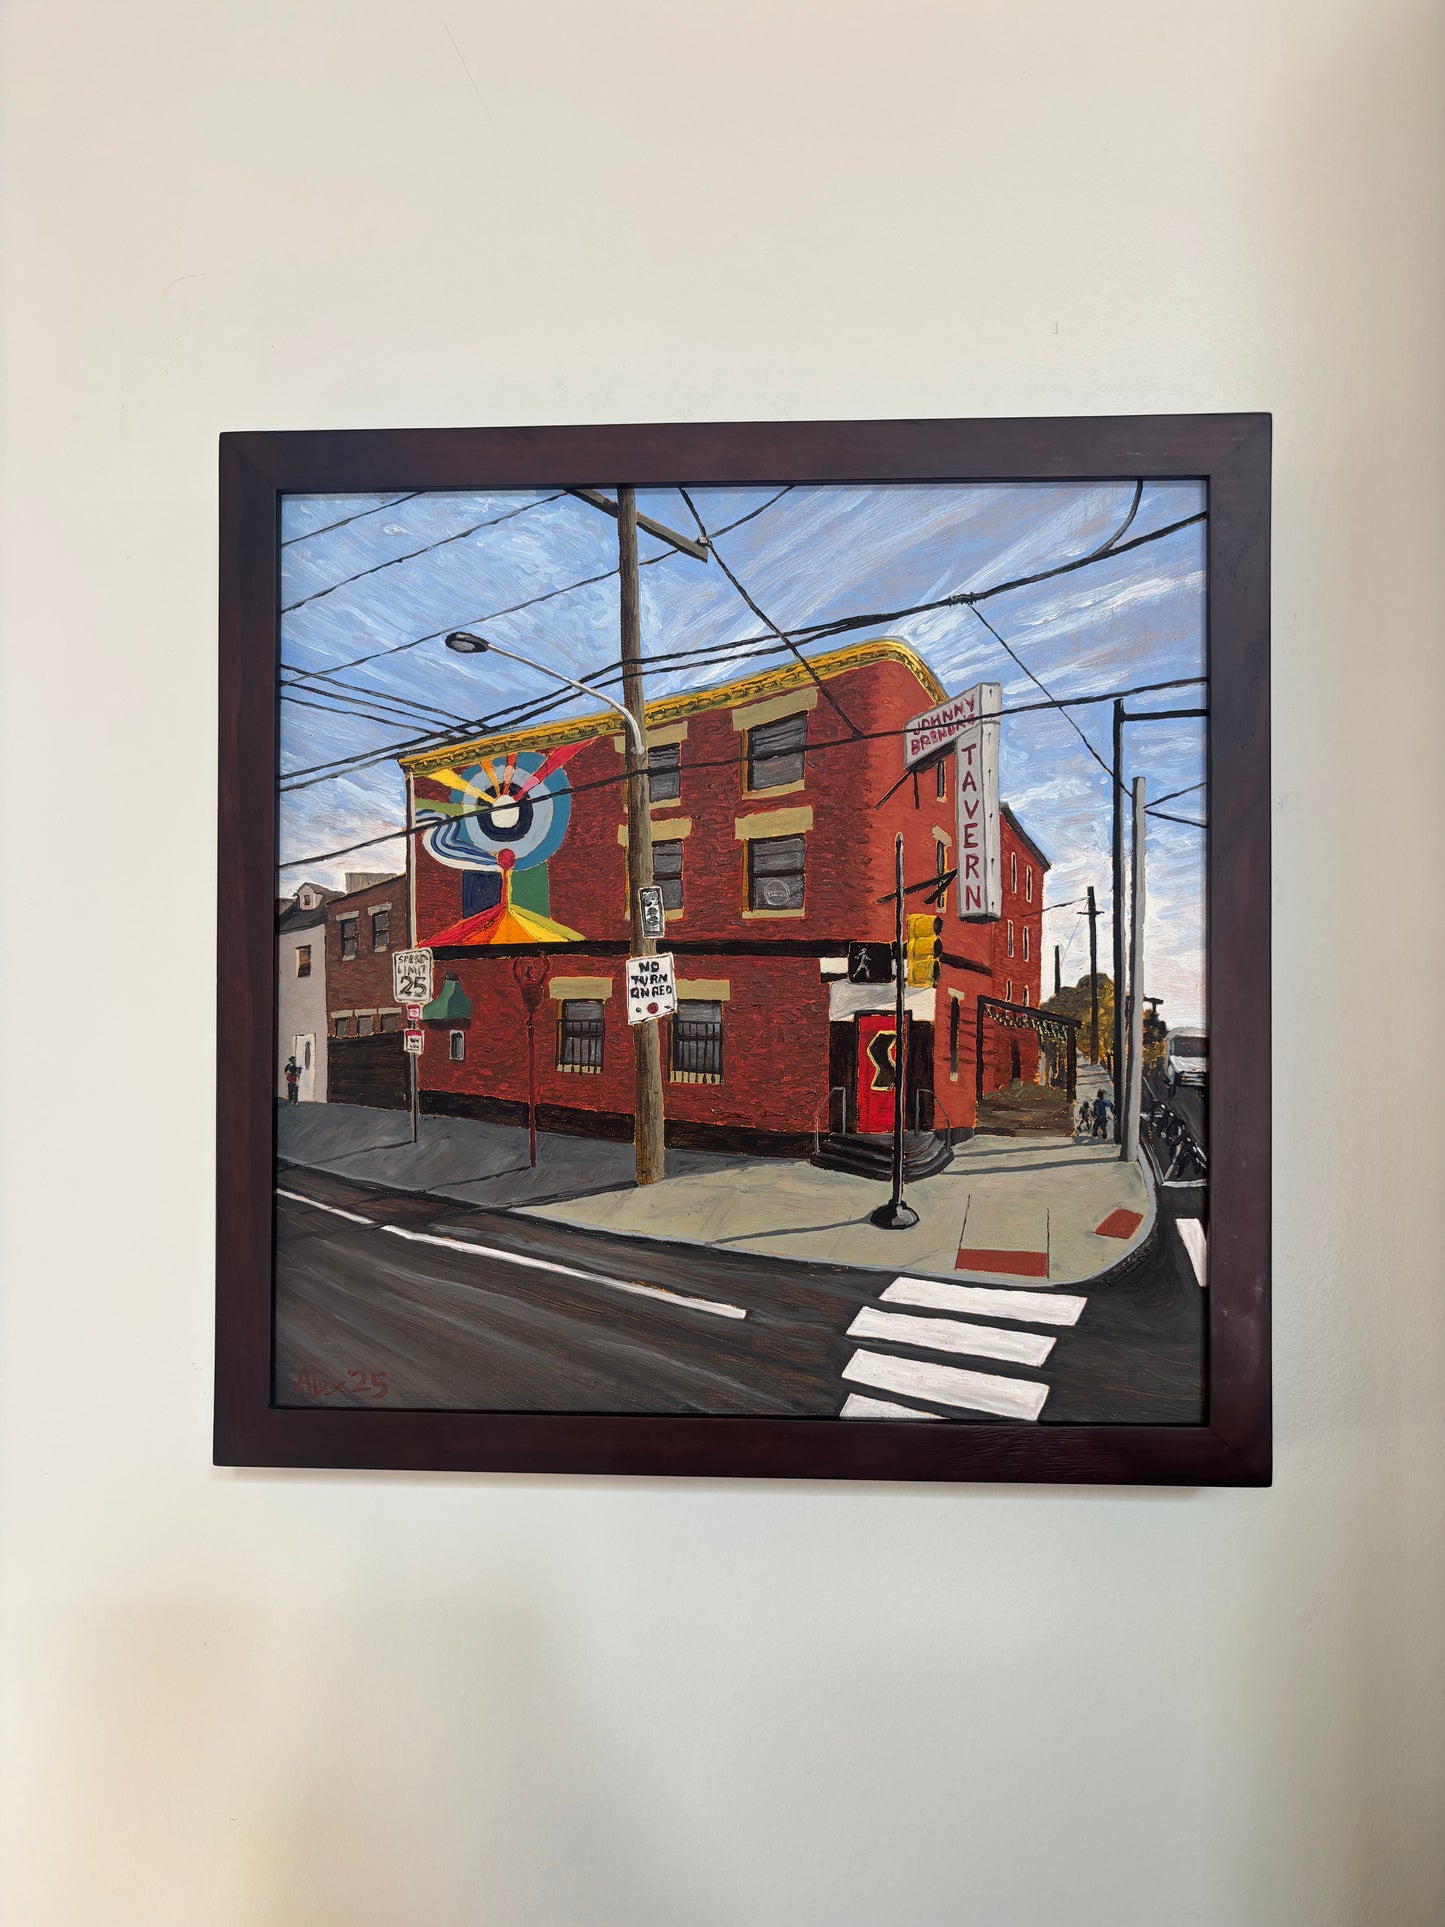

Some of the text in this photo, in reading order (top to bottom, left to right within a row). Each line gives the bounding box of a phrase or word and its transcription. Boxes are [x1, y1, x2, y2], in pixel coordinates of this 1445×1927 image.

[914, 694, 975, 736] JOHNNY
[961, 743, 981, 911] TAVERN
[398, 954, 427, 964] SPEED
[397, 964, 426, 976] LIMIT
[638, 961, 660, 973] NO
[400, 975, 427, 997] 25
[630, 973, 668, 987] TURN
[630, 984, 673, 999] ON RED
